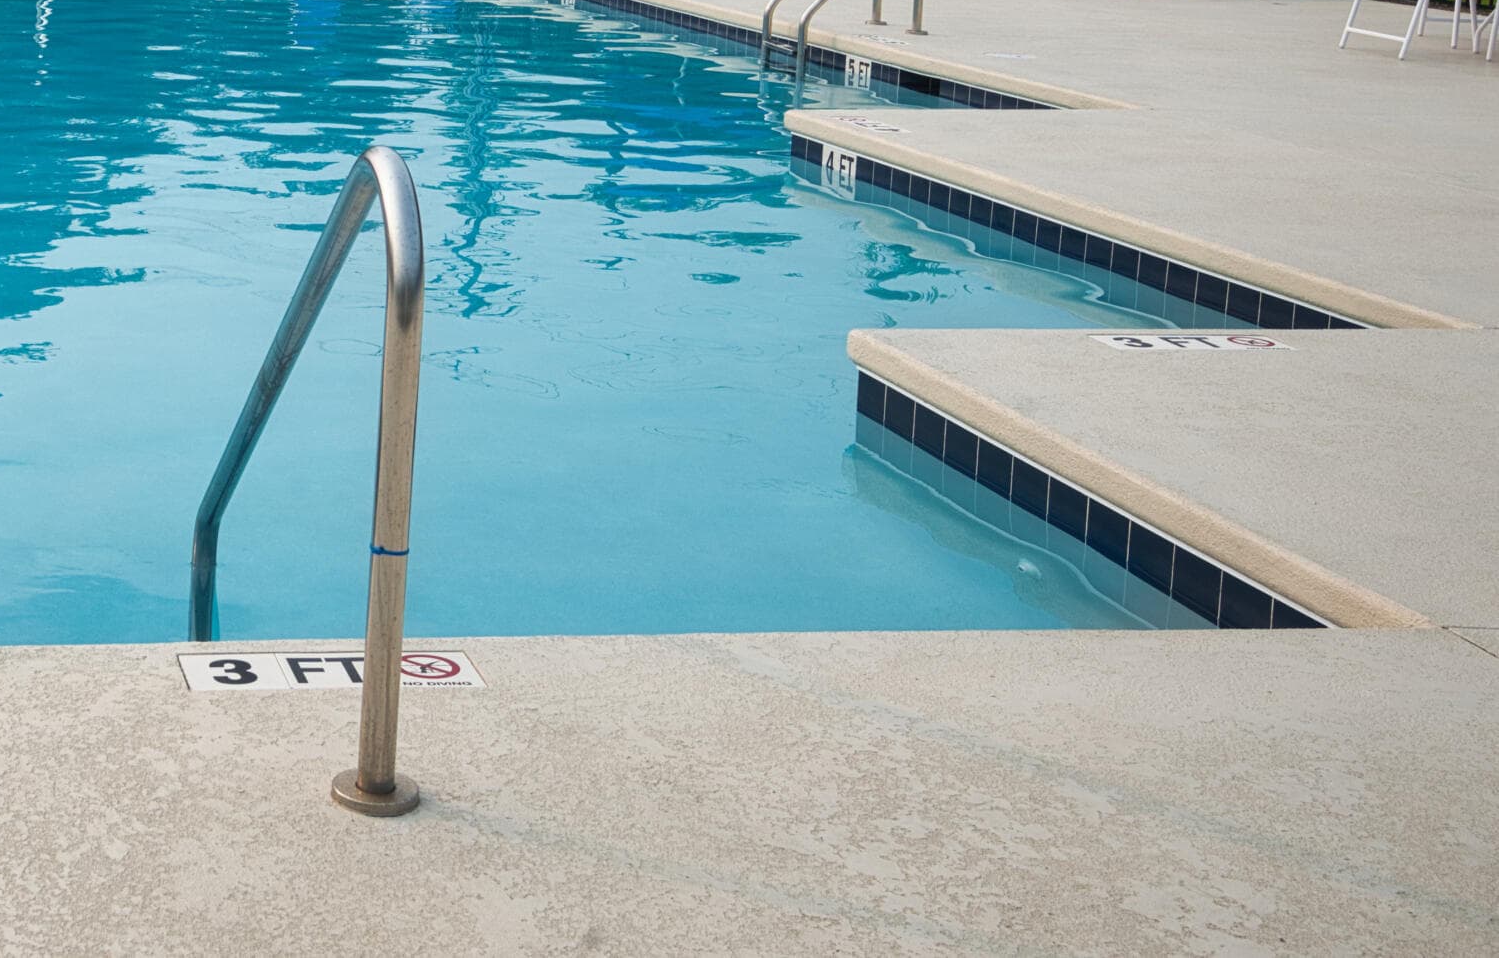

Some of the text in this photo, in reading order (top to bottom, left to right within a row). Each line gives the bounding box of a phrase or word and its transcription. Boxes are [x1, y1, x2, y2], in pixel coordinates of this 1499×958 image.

[826, 151, 854, 176] 4 FT
[1112, 336, 1221, 348] 3 FT
[208, 657, 365, 685] 3 FT
